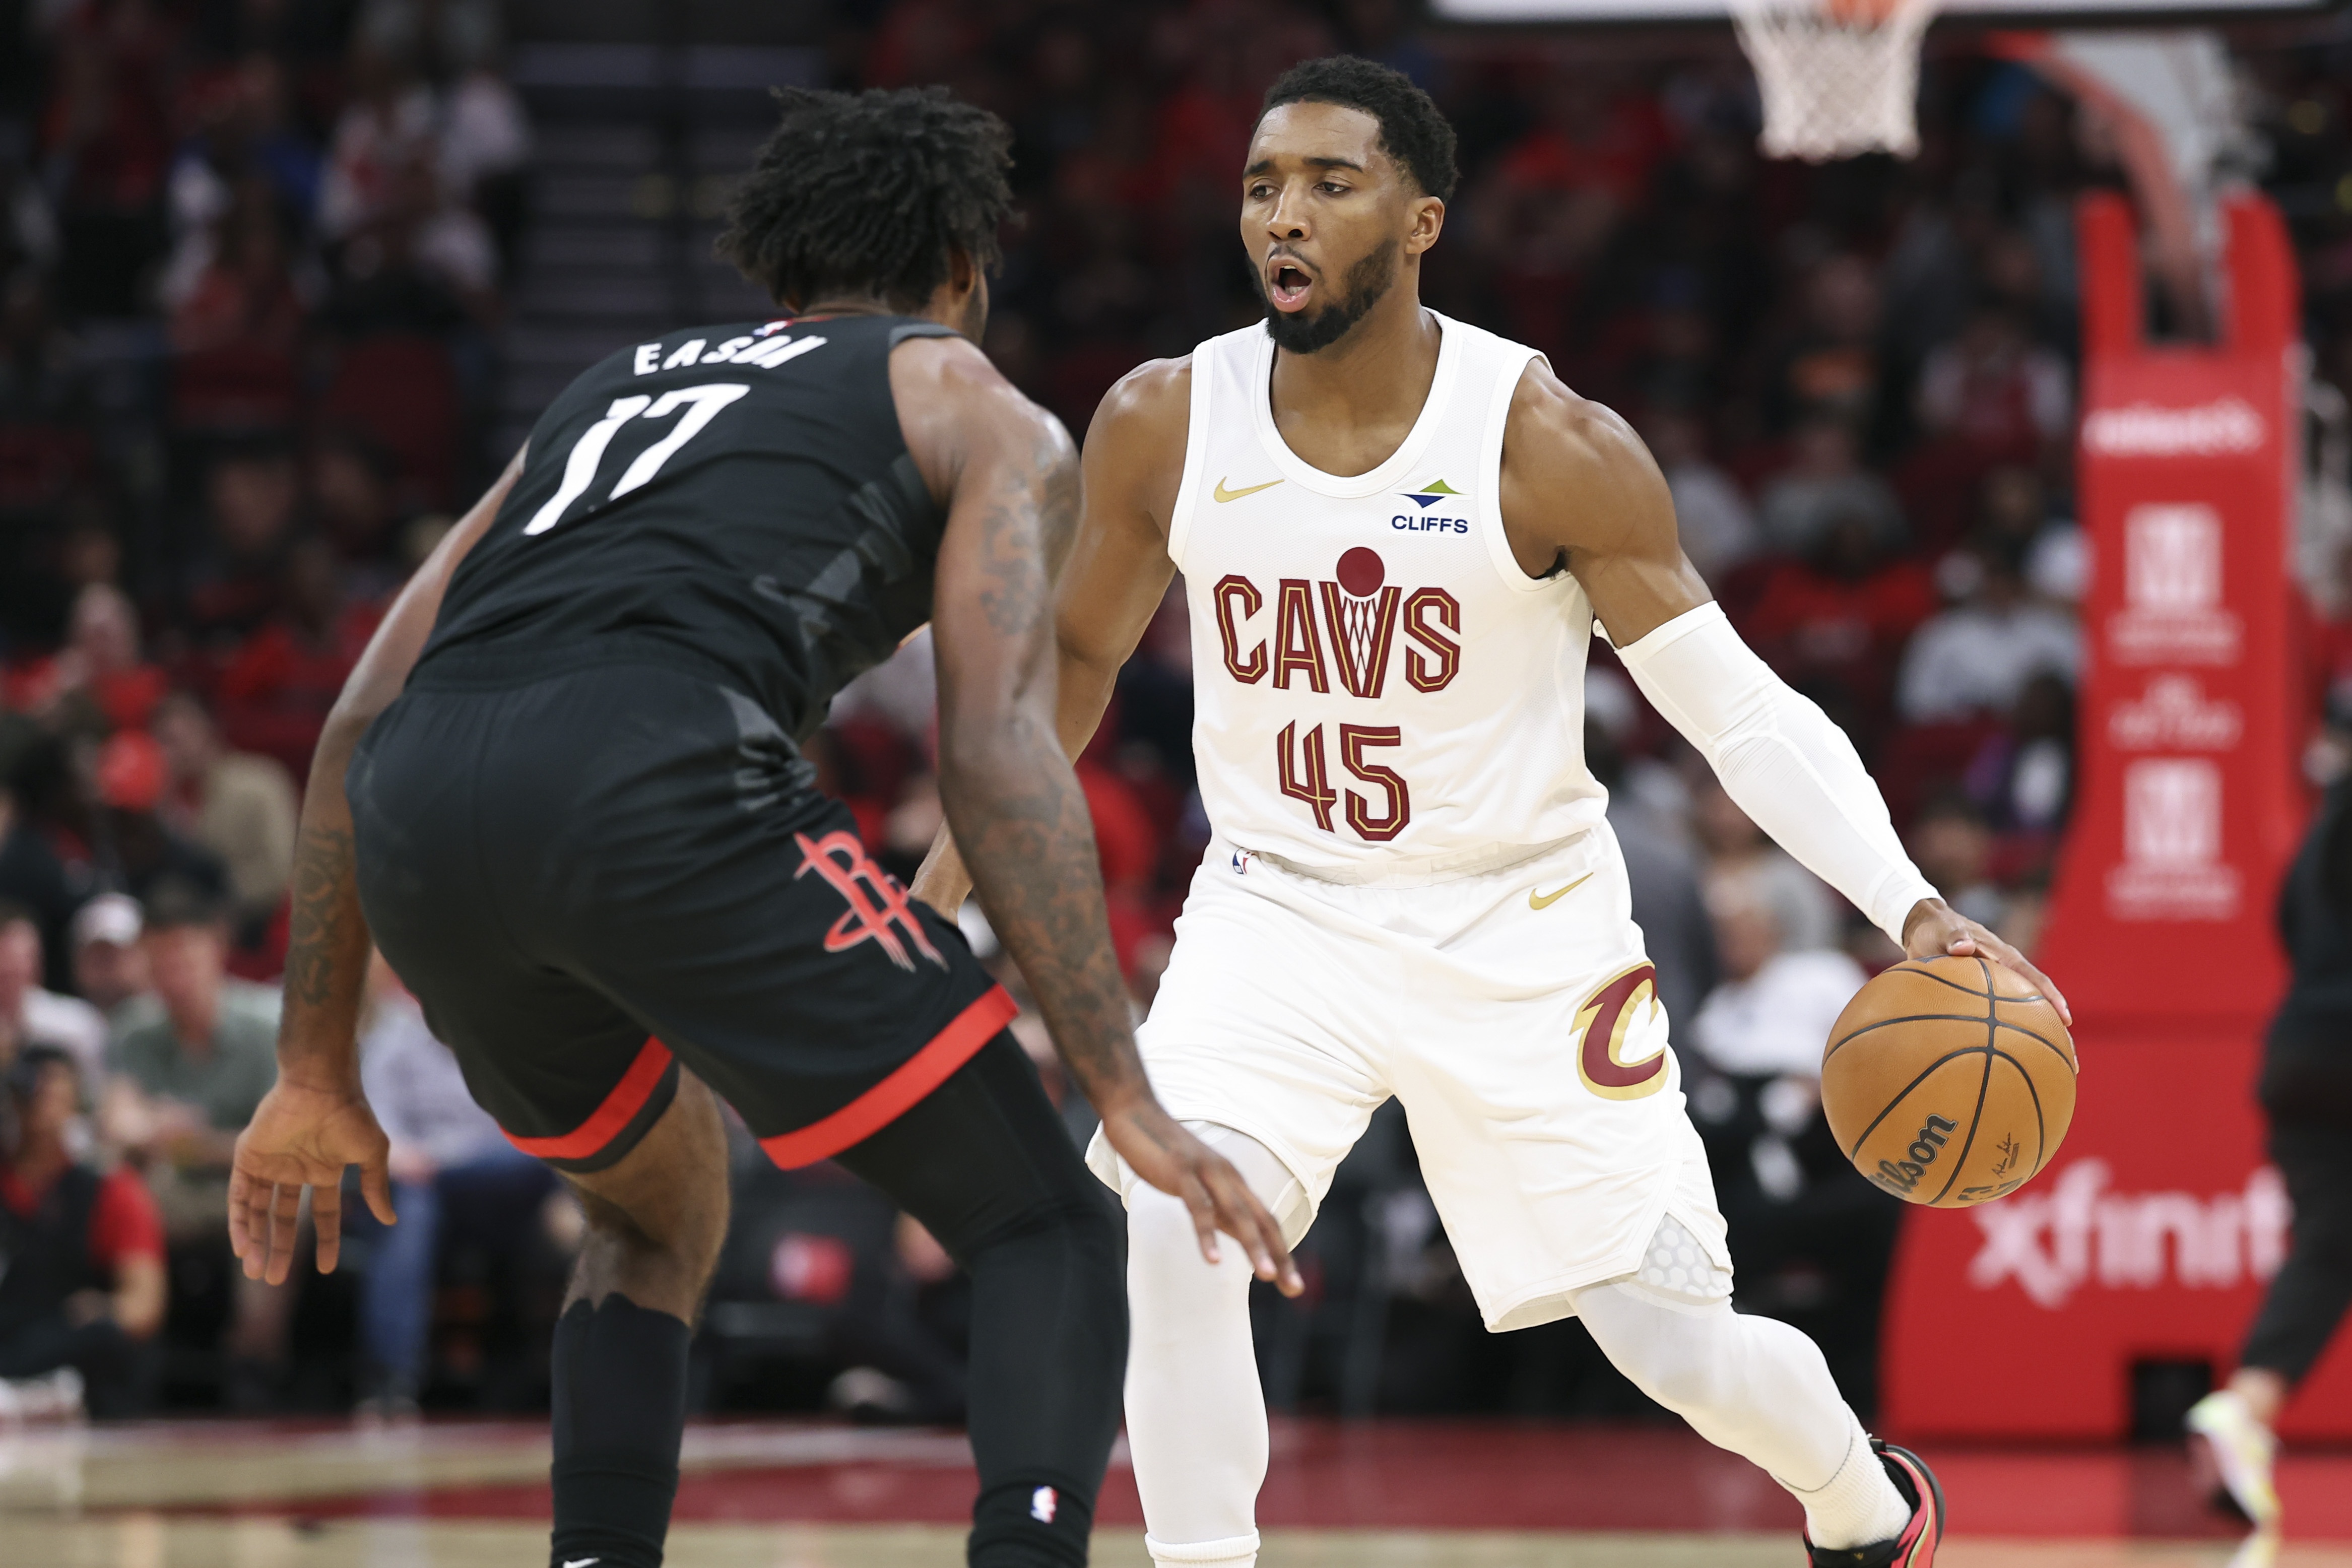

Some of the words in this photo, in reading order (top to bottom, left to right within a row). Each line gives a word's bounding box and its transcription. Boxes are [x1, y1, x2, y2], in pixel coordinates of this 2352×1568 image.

[634, 335, 828, 375] EASON
[524, 383, 751, 536] 17
[1391, 514, 1469, 534] CLIFFS
[1213, 574, 1461, 699] CAVS
[1277, 719, 1410, 841] 45
[1867, 1113, 1959, 1199] ilson
[1968, 1157, 2294, 1309] xfinit
